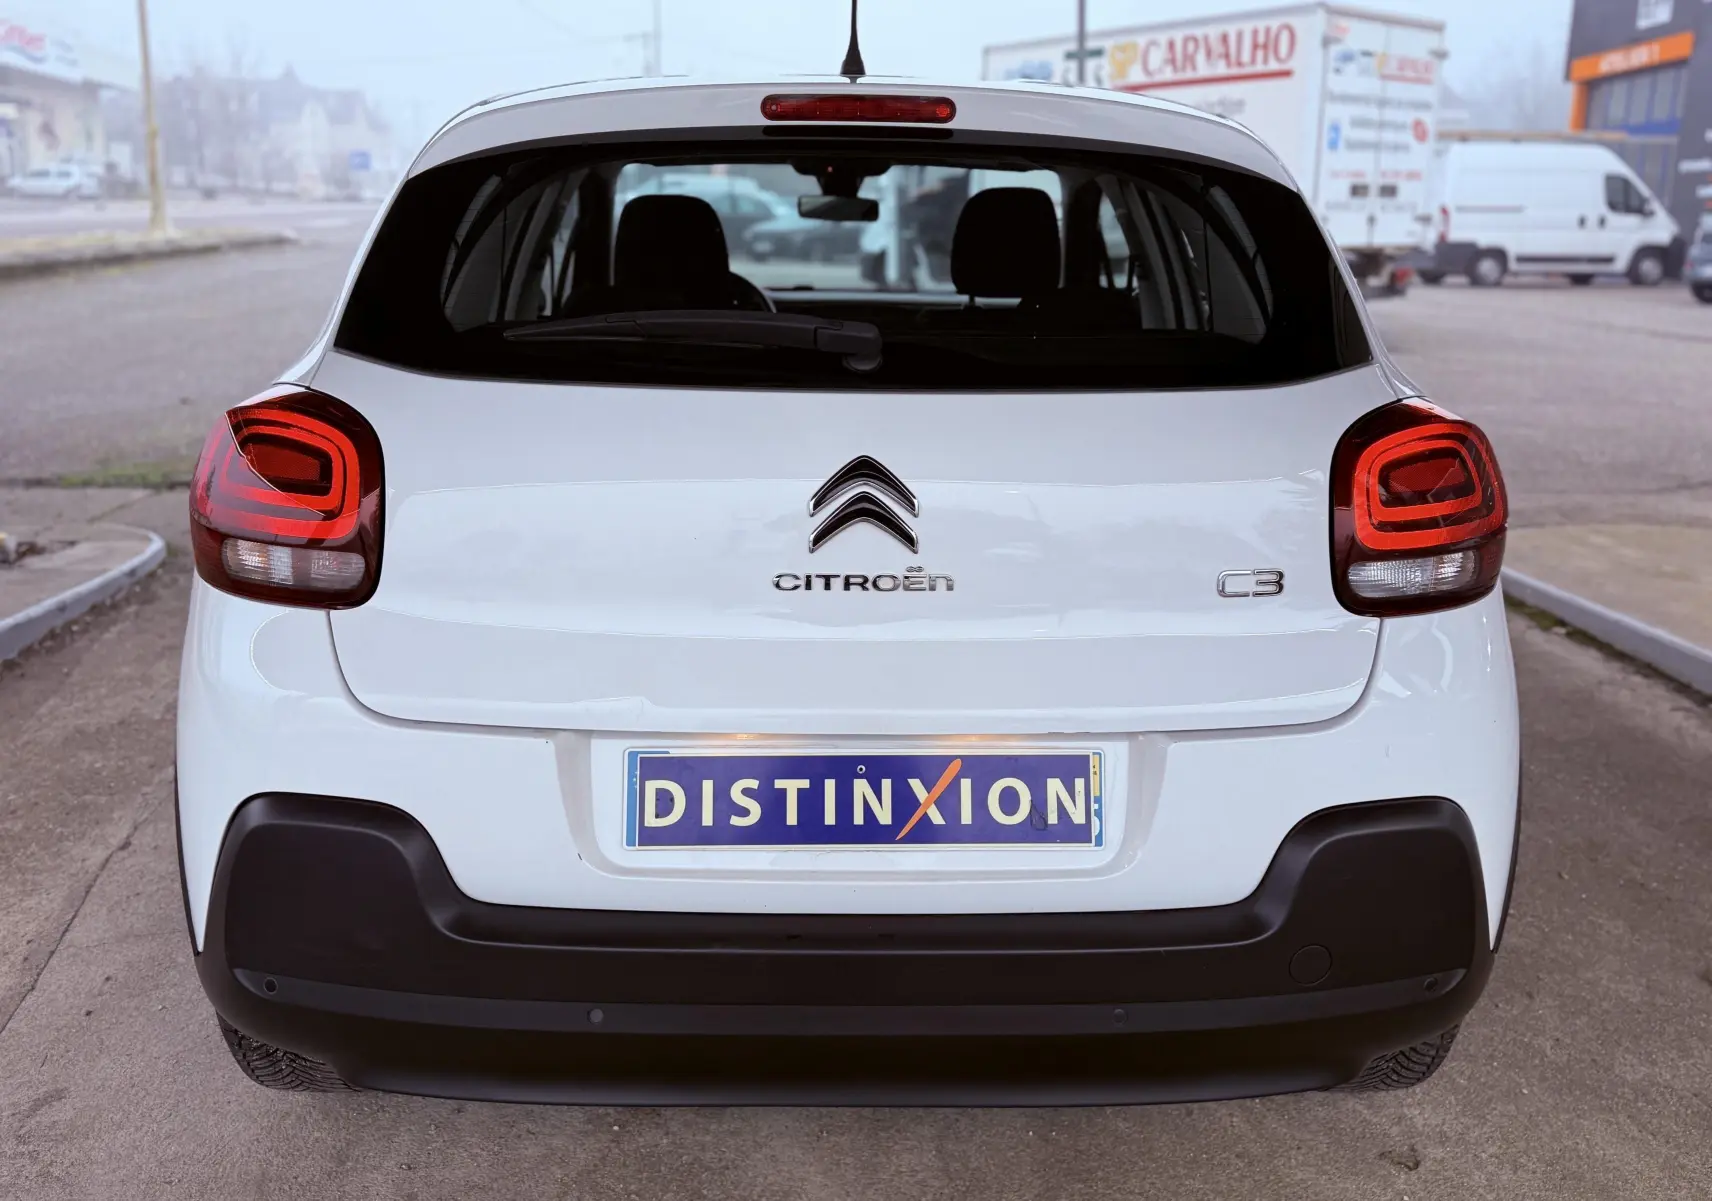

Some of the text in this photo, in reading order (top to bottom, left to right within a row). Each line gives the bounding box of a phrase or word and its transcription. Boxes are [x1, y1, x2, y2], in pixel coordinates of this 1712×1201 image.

[1141, 23, 1297, 78] CARVALHO
[1217, 569, 1284, 597] C3
[643, 759, 1086, 840] DISTINXION
